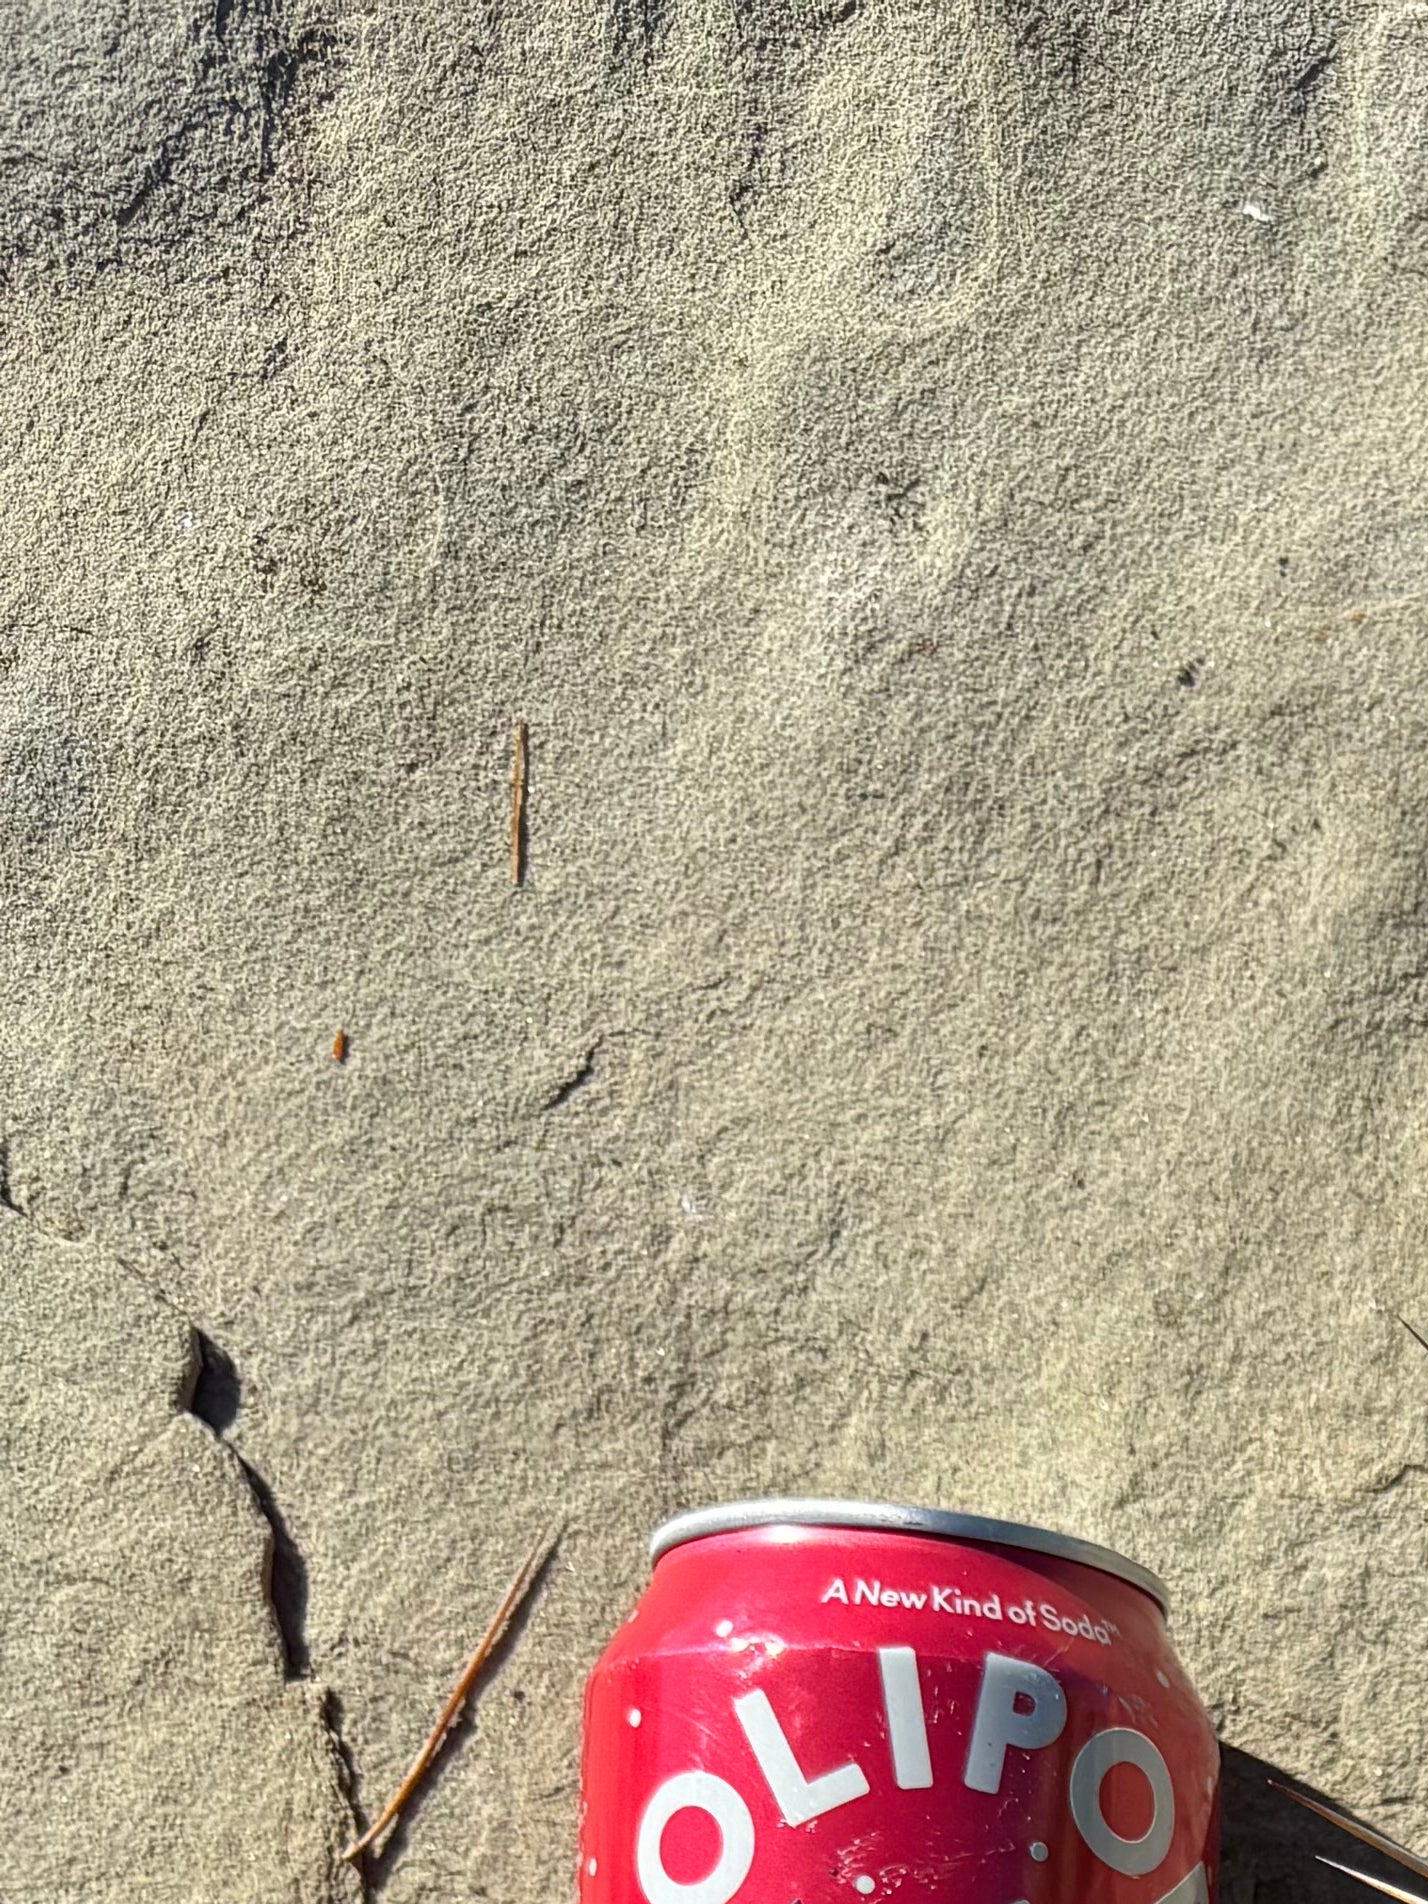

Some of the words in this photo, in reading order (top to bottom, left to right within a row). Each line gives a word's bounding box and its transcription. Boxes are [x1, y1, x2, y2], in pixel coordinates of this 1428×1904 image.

[821, 1579, 849, 1605] A
[855, 1581, 927, 1610] New
[931, 1587, 1002, 1621] Kind
[1008, 1600, 1039, 1628] of
